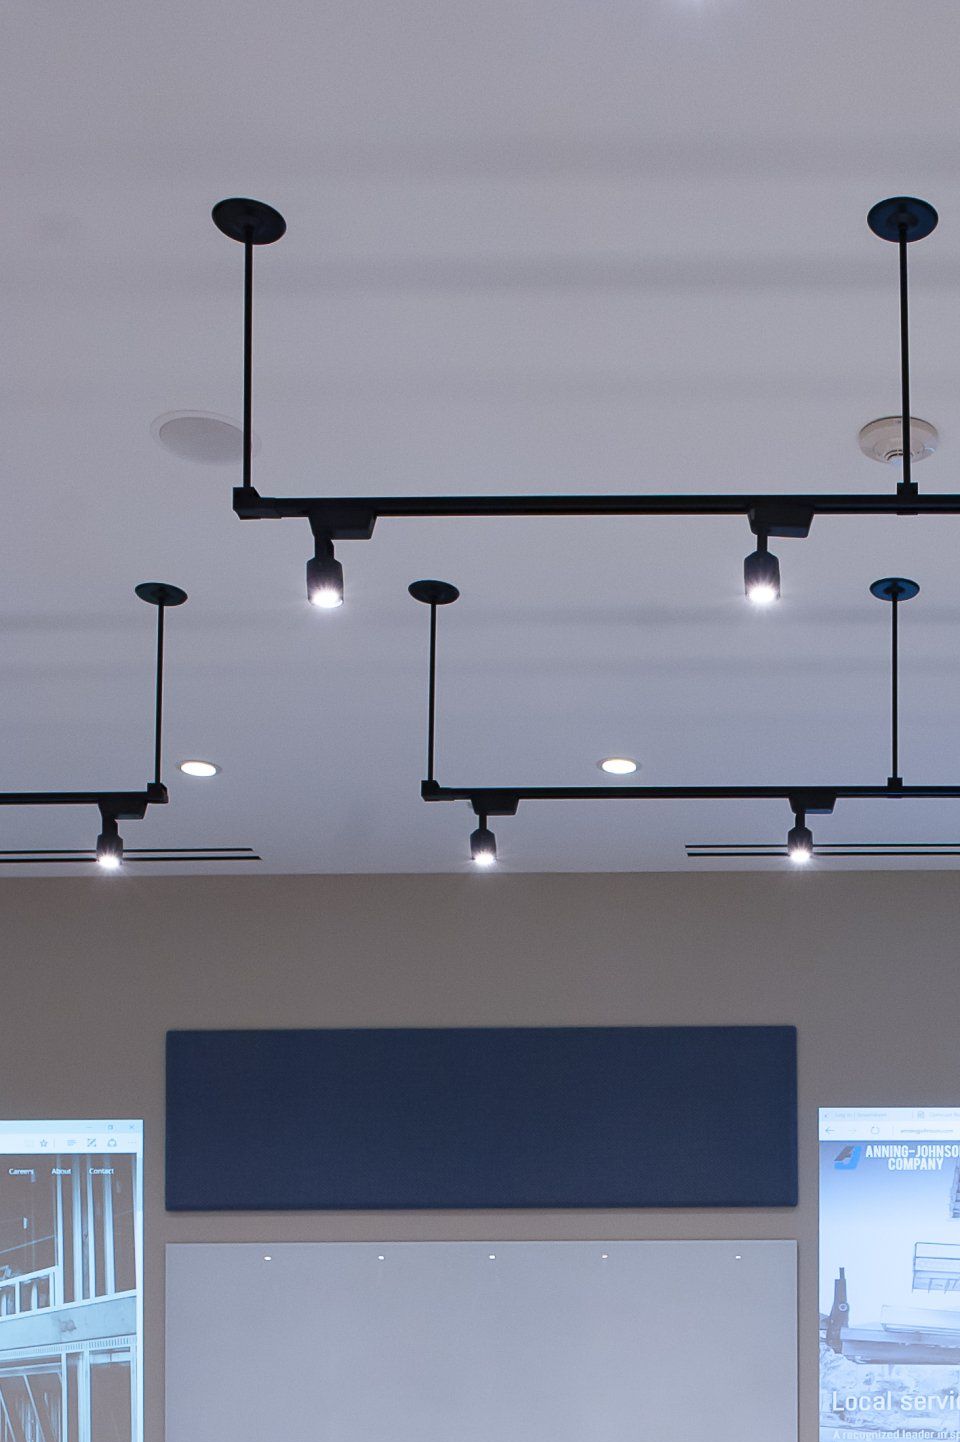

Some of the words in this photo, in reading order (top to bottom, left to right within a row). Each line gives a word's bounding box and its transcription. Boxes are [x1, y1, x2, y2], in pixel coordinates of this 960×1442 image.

[888, 1158, 944, 1171] COMPANY
[8, 1167, 34, 1175] Careers
[51, 1167, 72, 1175] About
[88, 1167, 114, 1175] Contact
[832, 1390, 892, 1412] Local
[833, 1431, 840, 1440] A
[843, 1429, 900, 1441] recognized
[902, 1429, 939, 1440] leader
